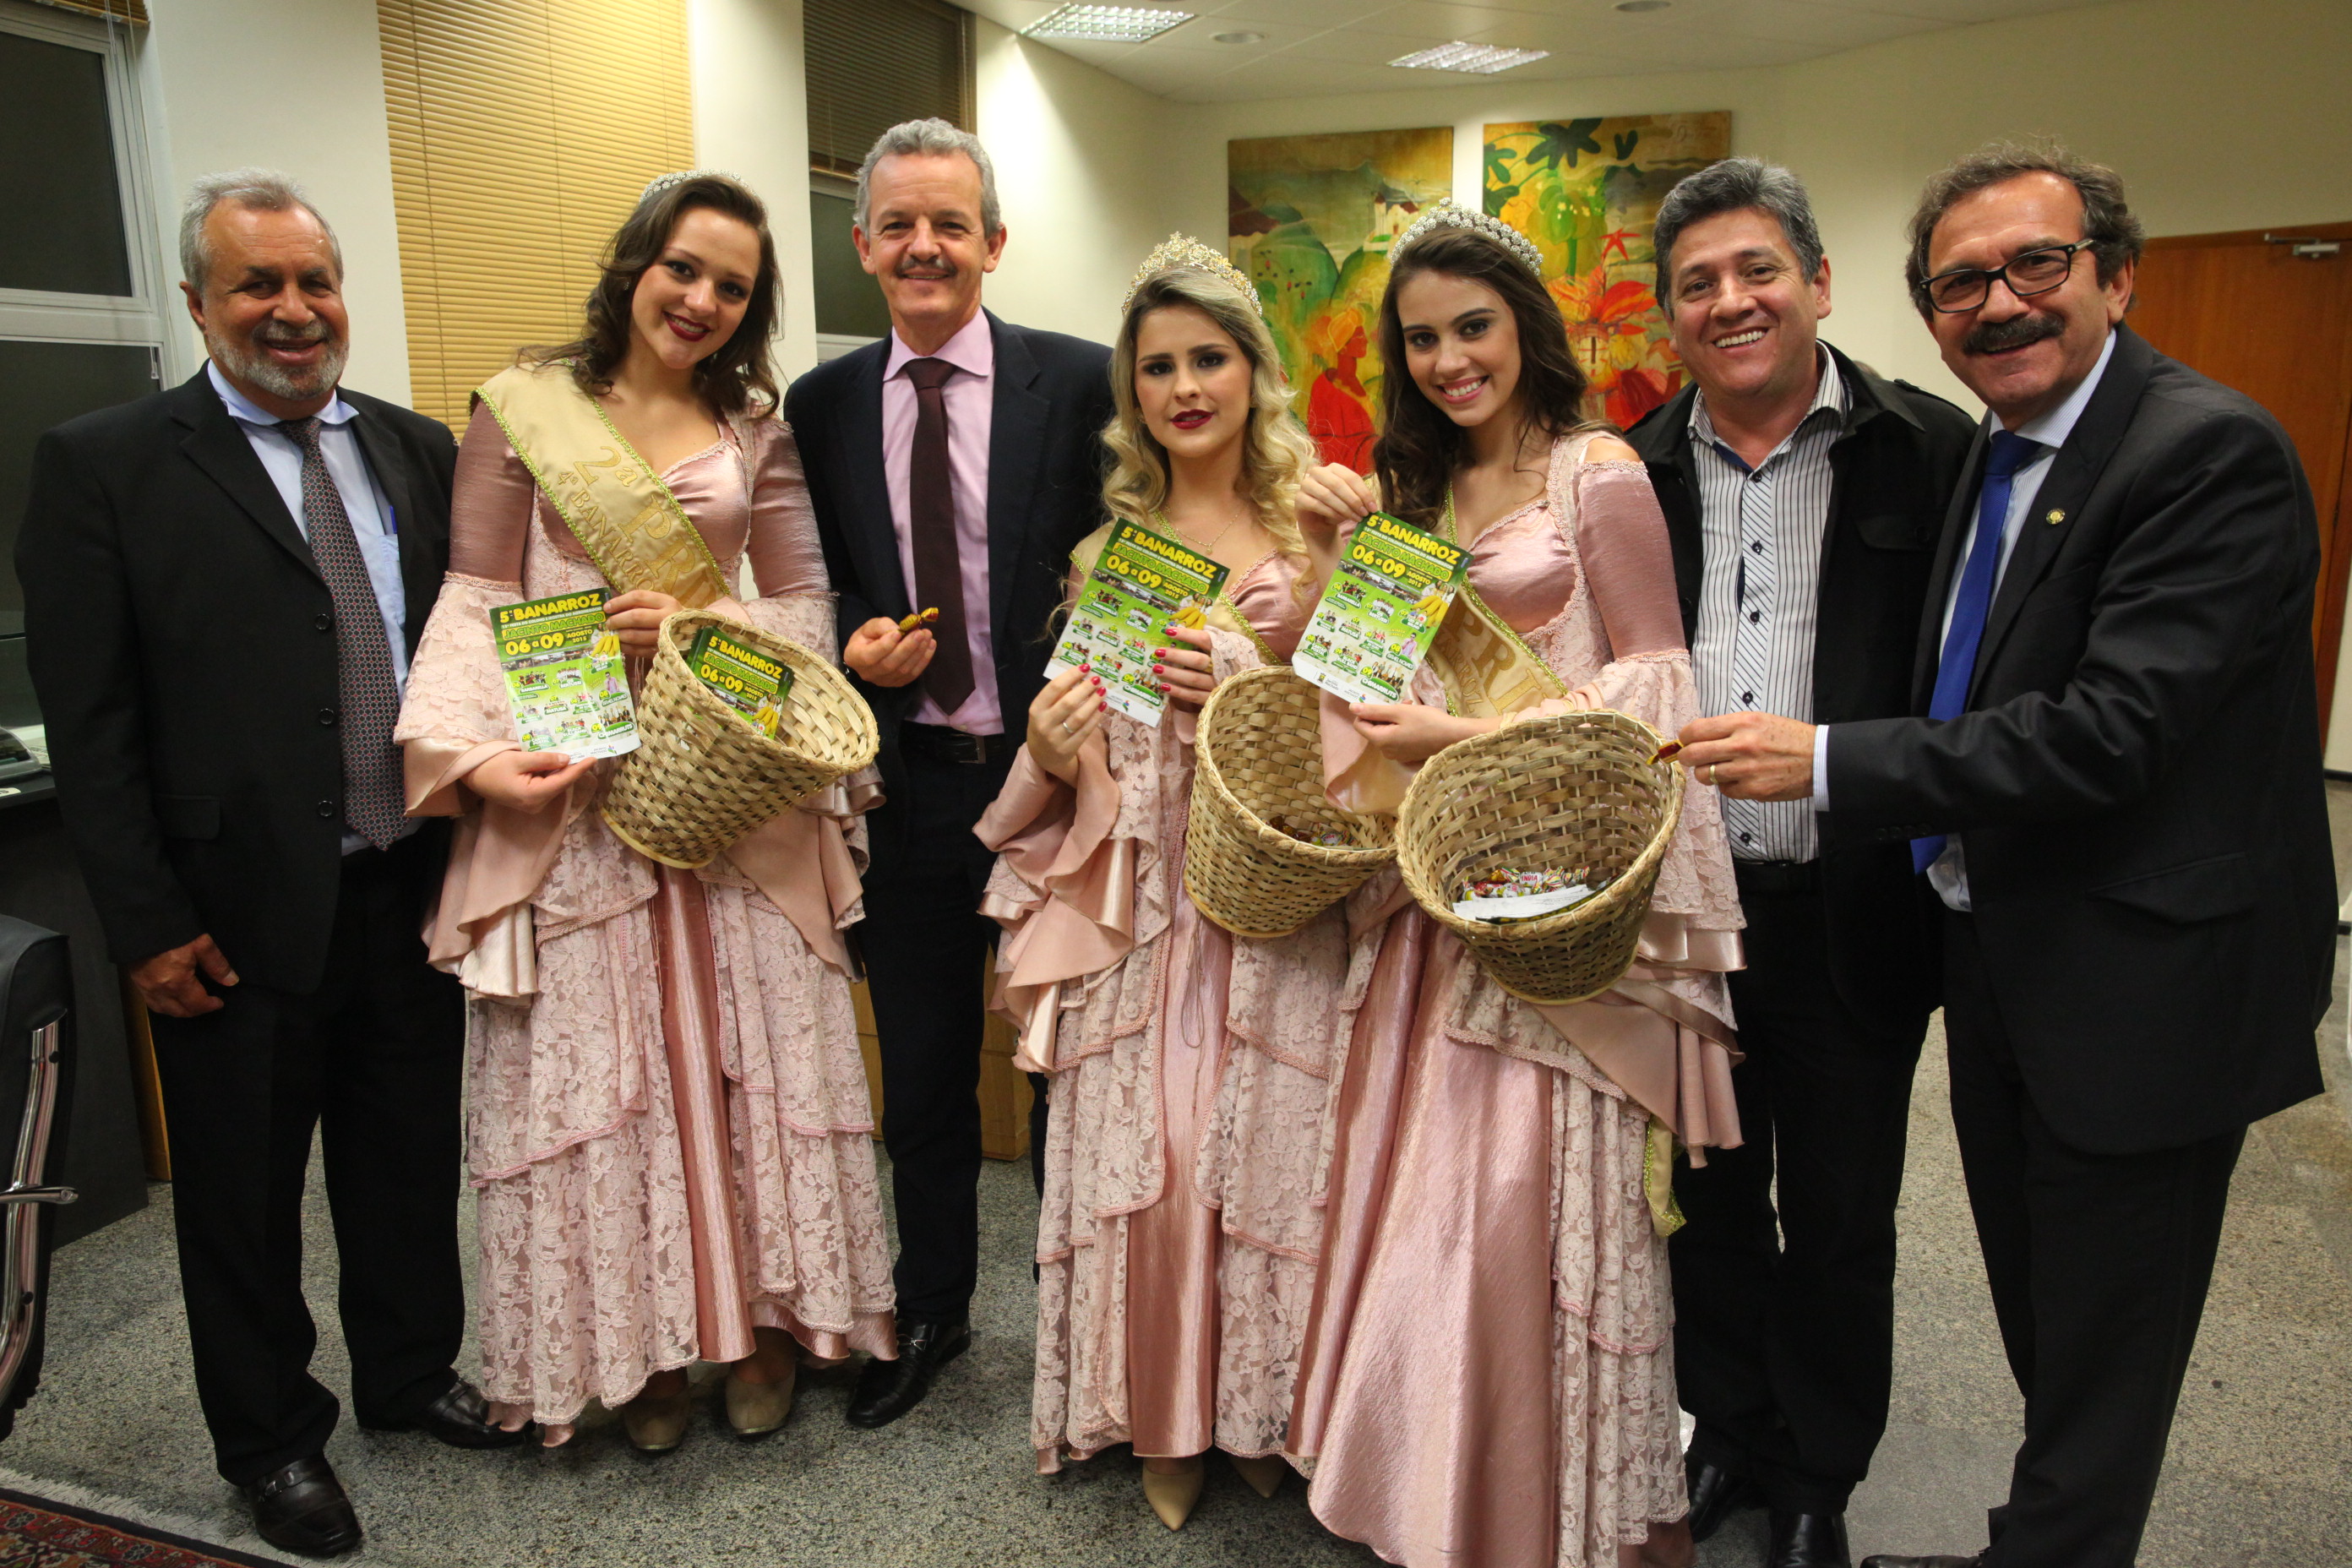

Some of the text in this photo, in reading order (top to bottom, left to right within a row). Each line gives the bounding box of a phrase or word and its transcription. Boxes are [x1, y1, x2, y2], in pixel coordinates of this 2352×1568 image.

[570, 488, 655, 591] BANARRO
[1380, 520, 1461, 565] BANARROZ
[1114, 545, 1157, 568] JACINTO
[1155, 564, 1206, 592] MACHADO
[1134, 531, 1217, 579] BANARROZ
[1353, 545, 1375, 565] 06
[1375, 558, 1382, 566] a
[1382, 558, 1406, 578] 09
[1360, 533, 1402, 558] JACINTO
[1399, 552, 1449, 580] MACHADO
[1107, 555, 1130, 574] 06
[1138, 569, 1162, 588] 09
[1407, 571, 1431, 585] AGOSTO
[1408, 578, 1423, 588] 2015
[1163, 582, 1189, 596] AGOSTO
[1165, 589, 1179, 599] 2015
[513, 593, 602, 621] BANARROZ
[506, 612, 604, 640] JACINTO MACHADO
[566, 629, 592, 638] AGOSTO
[504, 638, 531, 656] 06
[539, 631, 565, 650] 09
[1390, 643, 1401, 652] 08
[705, 654, 738, 674] JACINTO
[737, 669, 776, 693] MACHADO
[719, 640, 783, 679] BANARROZ
[1362, 666, 1373, 675] 09
[700, 664, 719, 683] 06
[725, 676, 743, 693] 09
[744, 686, 764, 698] AGOSTO
[1361, 677, 1397, 698] CHIMARRUTS
